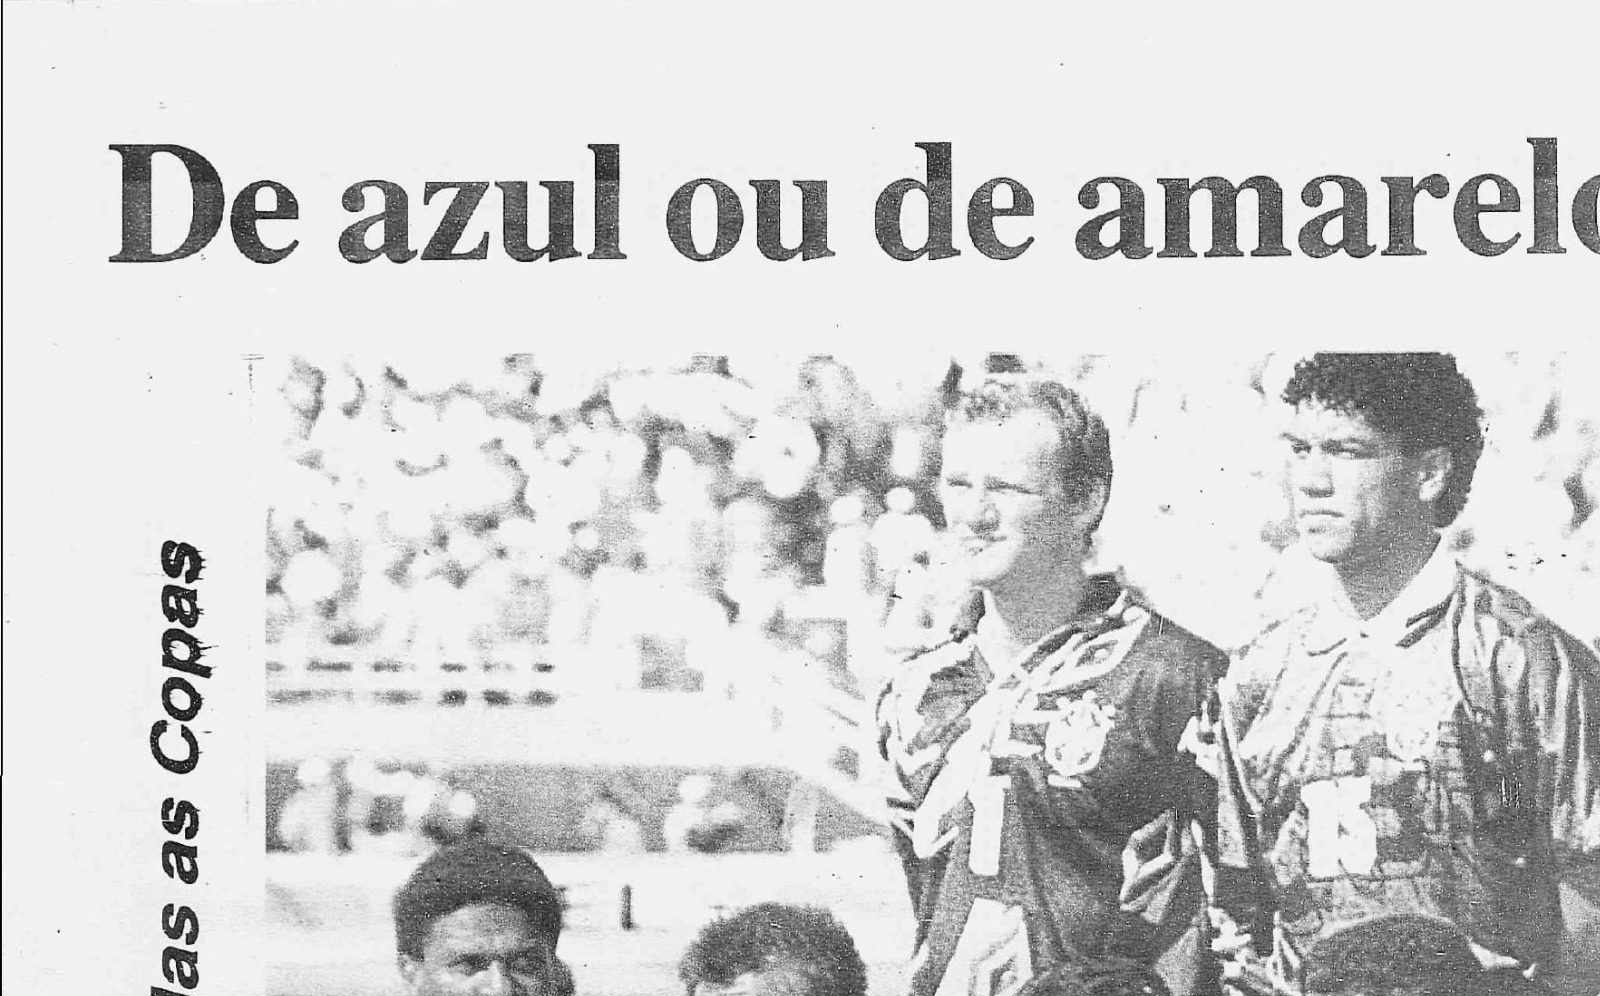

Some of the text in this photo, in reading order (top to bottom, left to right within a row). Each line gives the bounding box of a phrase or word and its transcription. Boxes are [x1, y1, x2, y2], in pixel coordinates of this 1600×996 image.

[109, 144, 299, 264] De
[339, 144, 627, 264] azul
[666, 178, 835, 262] ou
[875, 142, 1034, 261] de
[150, 540, 212, 774] Copas
[161, 798, 200, 884] as
